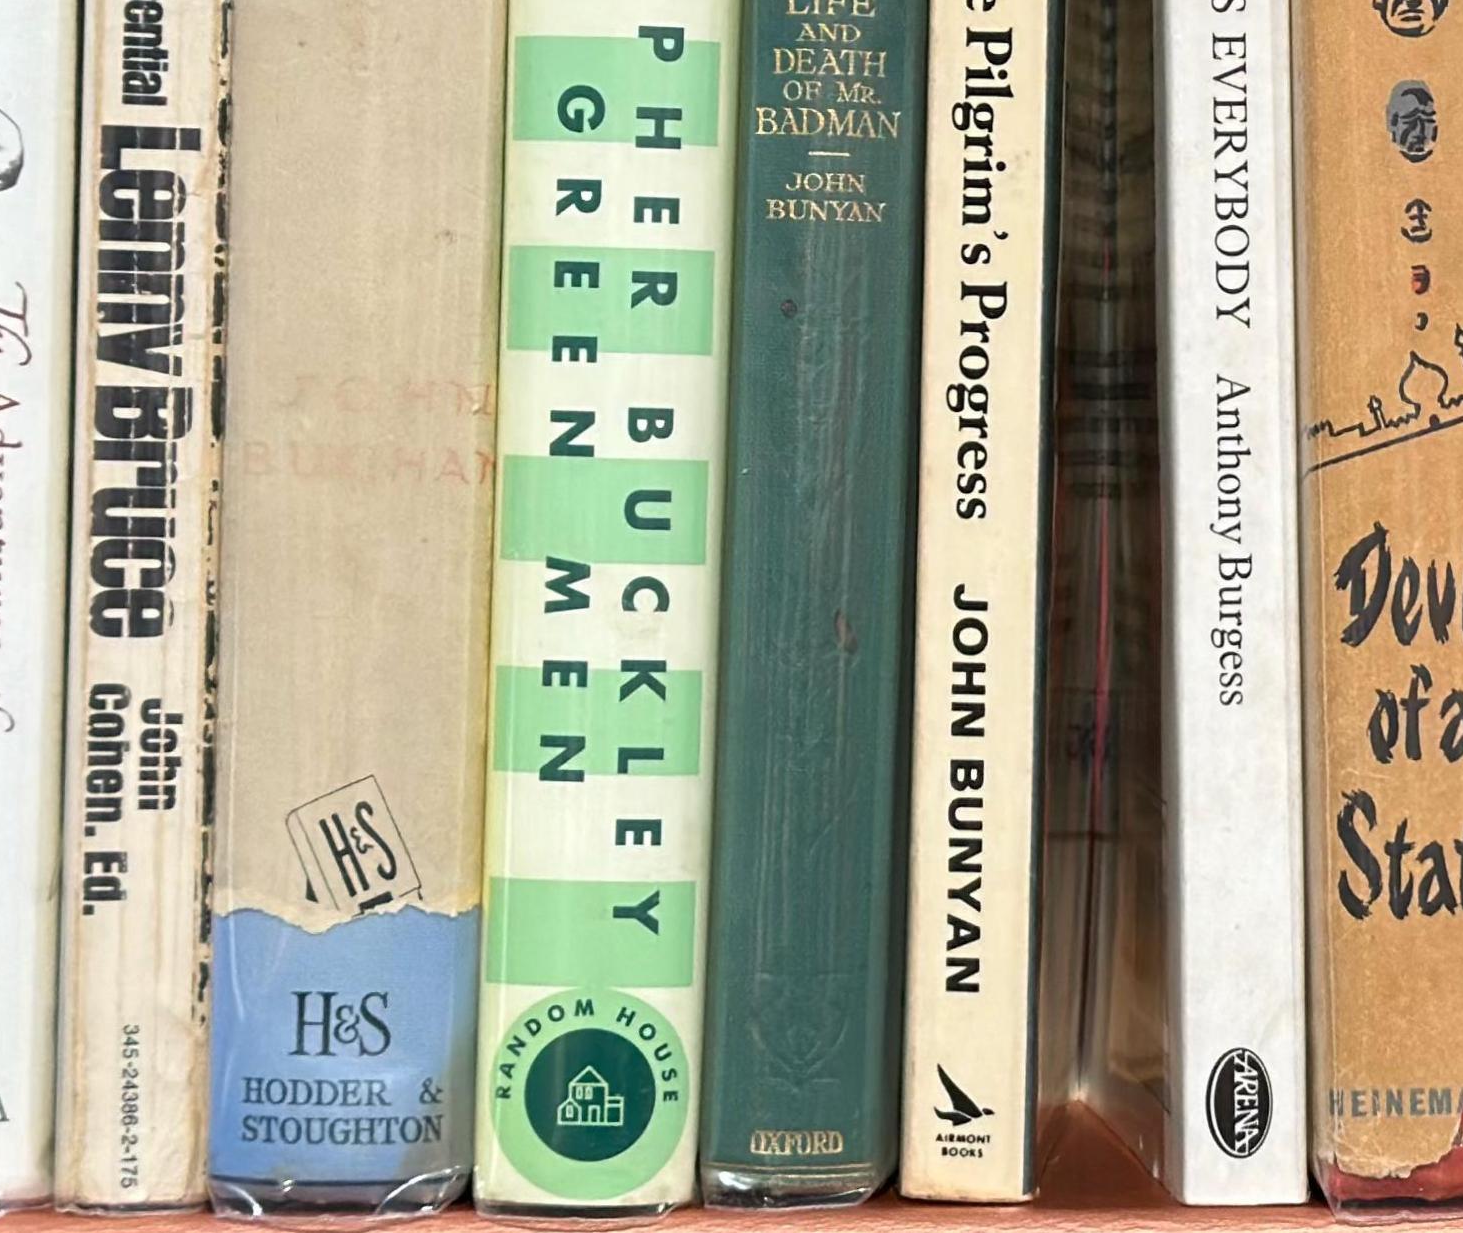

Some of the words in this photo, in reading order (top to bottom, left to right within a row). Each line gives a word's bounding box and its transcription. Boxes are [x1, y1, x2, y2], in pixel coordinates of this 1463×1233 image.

[772, 47, 887, 78] DEATH
[795, 23, 862, 43] AND
[755, 107, 902, 139] BADMAN
[783, 80, 822, 102] OF
[766, 199, 887, 223] BUNYAN
[785, 172, 866, 195] JOHN
[1211, 31, 1252, 329] EVERYBODY
[548, 84, 606, 457] GREEN
[946, 280, 1009, 521] Progress
[1210, 373, 1252, 545] Anthony
[89, 385, 194, 639] Bruce
[538, 555, 592, 782] MEN
[612, 407, 675, 935] BUCKLEY
[951, 583, 990, 739] JOHN
[1210, 552, 1253, 707] Burgess
[137, 696, 184, 812] John
[1366, 664, 1433, 765] of
[82, 850, 129, 916] Ed.
[320, 800, 398, 897] H&S
[945, 758, 985, 993] BUNYAN
[288, 991, 393, 1057] H&S
[496, 998, 595, 1099] RANDOM
[615, 1005, 679, 1103] HOUSE
[241, 1076, 392, 1107] HODDER
[418, 1077, 444, 1105] &
[241, 1115, 445, 1146] STOUGHTON
[935, 1132, 992, 1145] AIRMONT
[1233, 1050, 1260, 1153] ARENA
[750, 1129, 844, 1155] OXFORD
[941, 1146, 984, 1159] BOOKS
